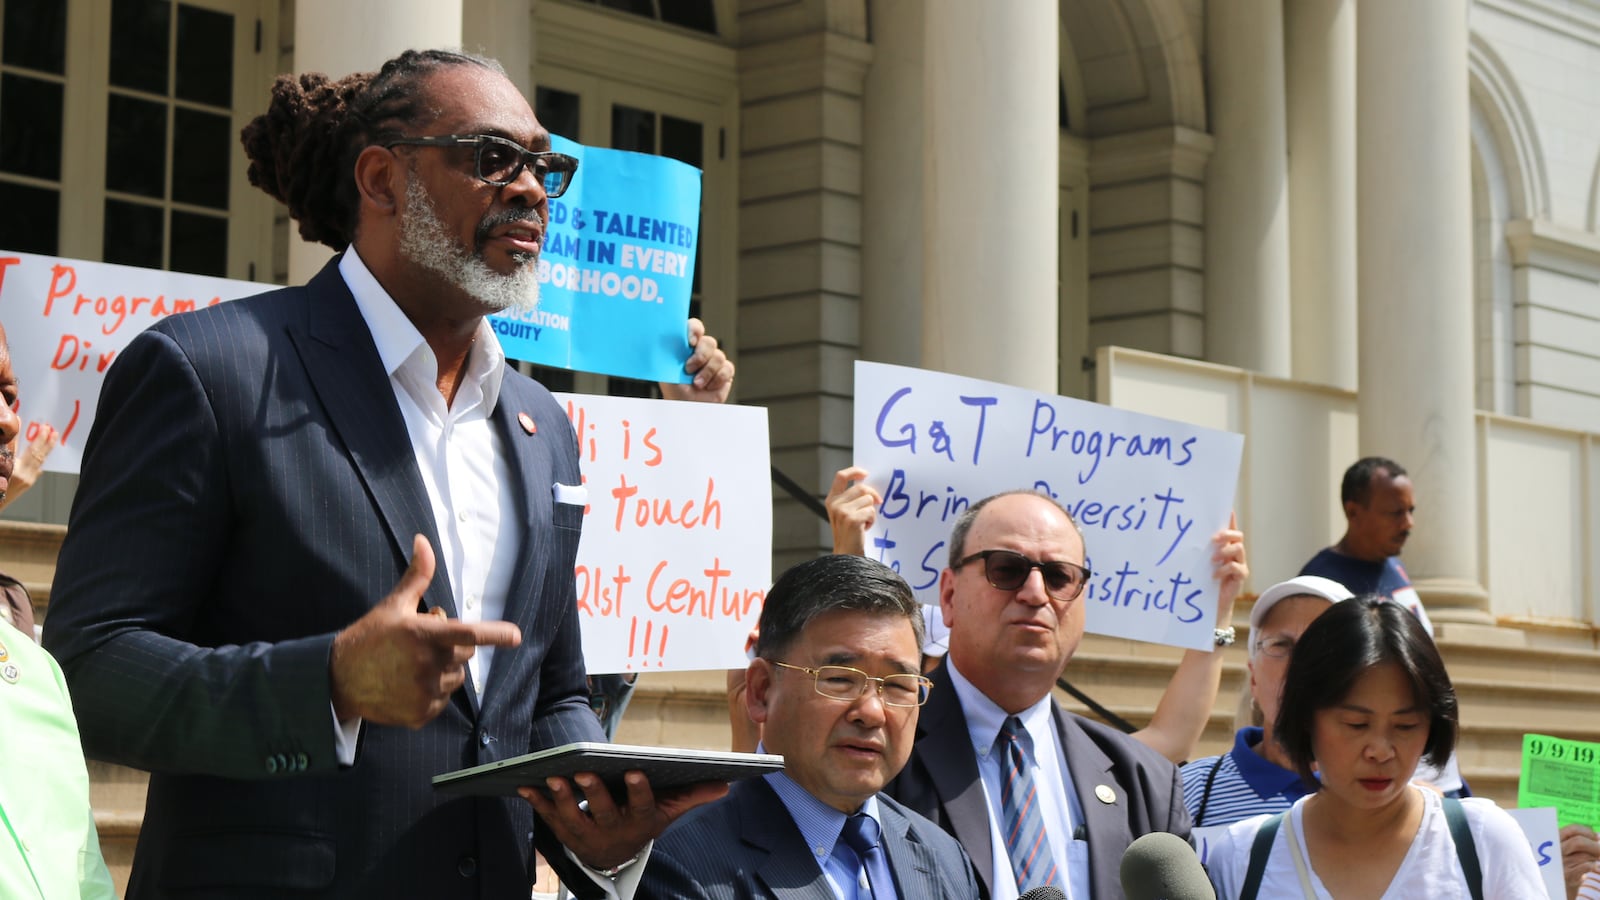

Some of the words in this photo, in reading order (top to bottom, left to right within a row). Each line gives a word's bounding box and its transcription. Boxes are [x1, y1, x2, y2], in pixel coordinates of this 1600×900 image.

[572, 207, 587, 230] &
[593, 209, 693, 249] TALENTED
[587, 239, 615, 265] IN
[621, 244, 689, 278] EVERY
[491, 319, 541, 341] EQUITY
[493, 303, 569, 331] DUCATION
[51, 334, 116, 372] Div
[621, 420, 663, 467] is
[875, 387, 998, 466] G&T
[1026, 398, 1197, 485] Programs
[879, 469, 970, 522] Brin
[1034, 479, 1193, 567] versity
[575, 564, 632, 618] 21st
[646, 556, 767, 622] Centur
[1084, 555, 1204, 624] istricts
[626, 616, 669, 670] !!!
[1530, 740, 1595, 764] 9/9/19
